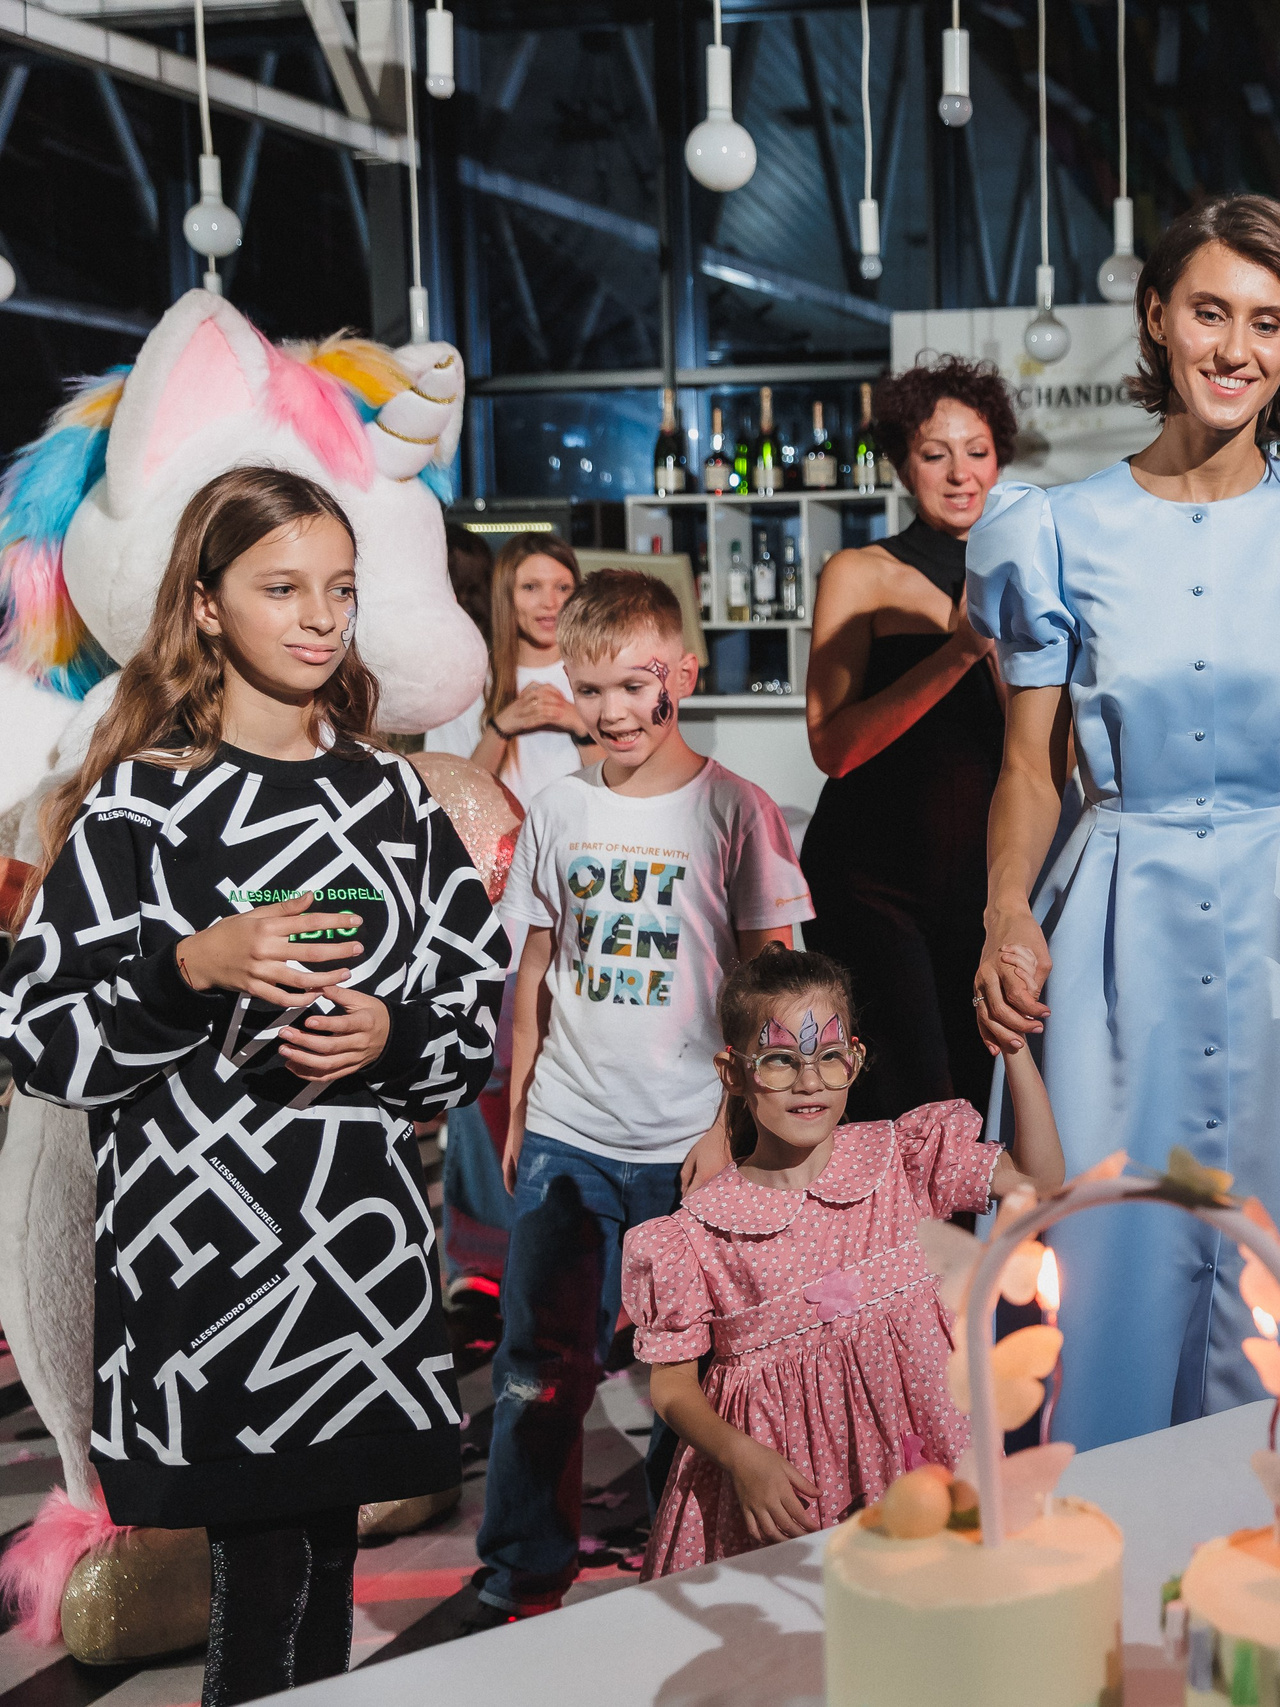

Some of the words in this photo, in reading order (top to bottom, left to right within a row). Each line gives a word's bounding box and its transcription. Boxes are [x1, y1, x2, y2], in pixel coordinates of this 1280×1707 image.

[1016, 382, 1132, 410] CHANDO
[569, 842, 579, 851] BE
[581, 842, 604, 851] PART
[605, 843, 620, 852] OF
[621, 844, 660, 856] NATURE
[662, 848, 690, 860] WITH
[228, 889, 324, 903] ALESSANDO
[327, 888, 386, 902] BORELLI
[567, 855, 686, 906] OUT
[571, 907, 681, 960] VEN
[572, 958, 675, 1007] TURE
[209, 1156, 254, 1204] ALESSANDRO
[251, 1201, 282, 1235] BORELLI
[189, 1302, 246, 1349] ALESSANDRO
[244, 1274, 282, 1305] BORELLI
